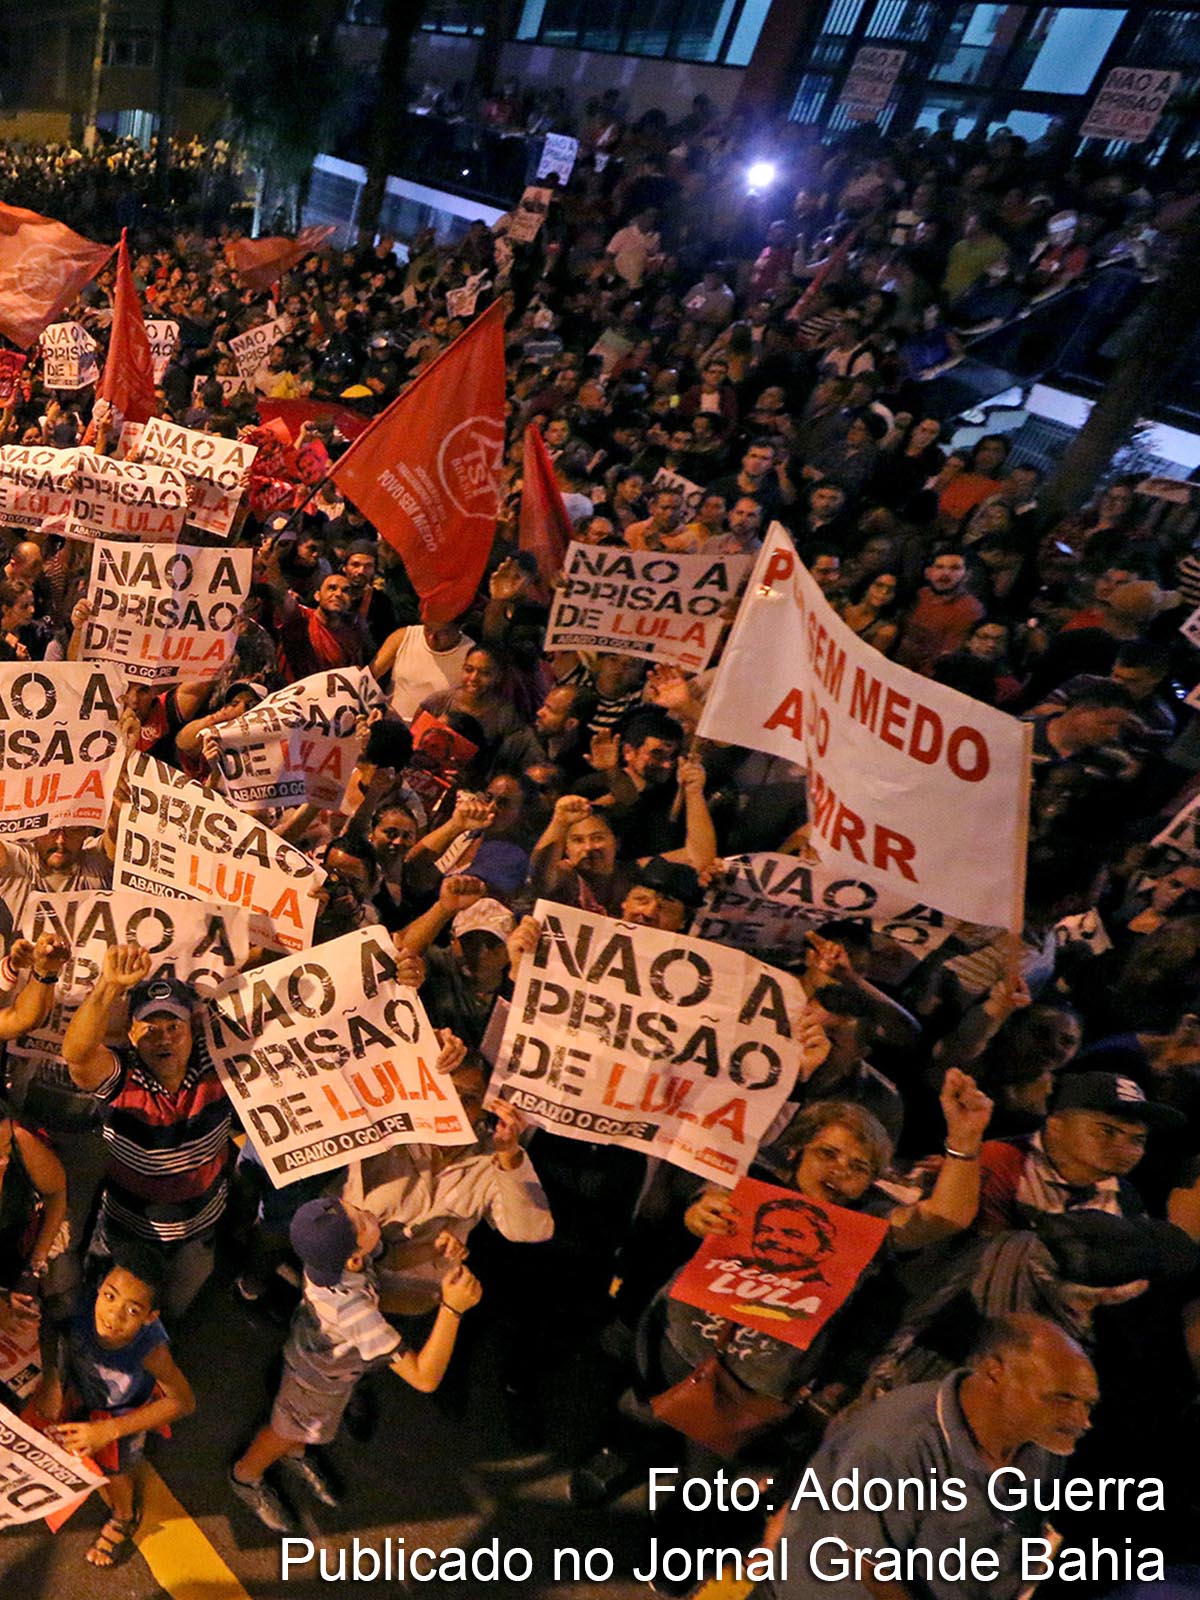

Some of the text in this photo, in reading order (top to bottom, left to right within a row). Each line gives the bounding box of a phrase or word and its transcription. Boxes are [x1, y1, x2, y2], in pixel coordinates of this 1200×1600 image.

[47, 363, 65, 377] DE
[13, 491, 72, 517] LULA
[73, 500, 176, 533] DE LULA
[100, 545, 194, 591] NÃO
[93, 588, 239, 632] PRISÃO
[554, 604, 706, 648] DE LULA
[85, 622, 225, 661] DE LULA
[139, 666, 173, 678] GOLPE
[807, 610, 848, 702] SEM
[848, 665, 990, 783] MEDO
[218, 742, 272, 781] DE
[233, 785, 277, 801] ABAIXO
[122, 829, 304, 929] DE LULA
[128, 876, 175, 900] ABAIXO
[32, 891, 175, 954] NÃO
[533, 915, 714, 1007] NÃO
[208, 963, 336, 1049] NÃO
[224, 998, 420, 1100] PRISÃO
[522, 978, 783, 1091] PRISÃO
[247, 1056, 448, 1147] DE LULA
[506, 1033, 748, 1144] DE LULA
[509, 1090, 650, 1139] ABAIXO O GOLPE
[284, 1115, 406, 1170] ABAIXO O GOLPE
[708, 1272, 822, 1314] LULA
[739, 1268, 804, 1289] COM
[28, 1447, 83, 1488] ABAIXO
